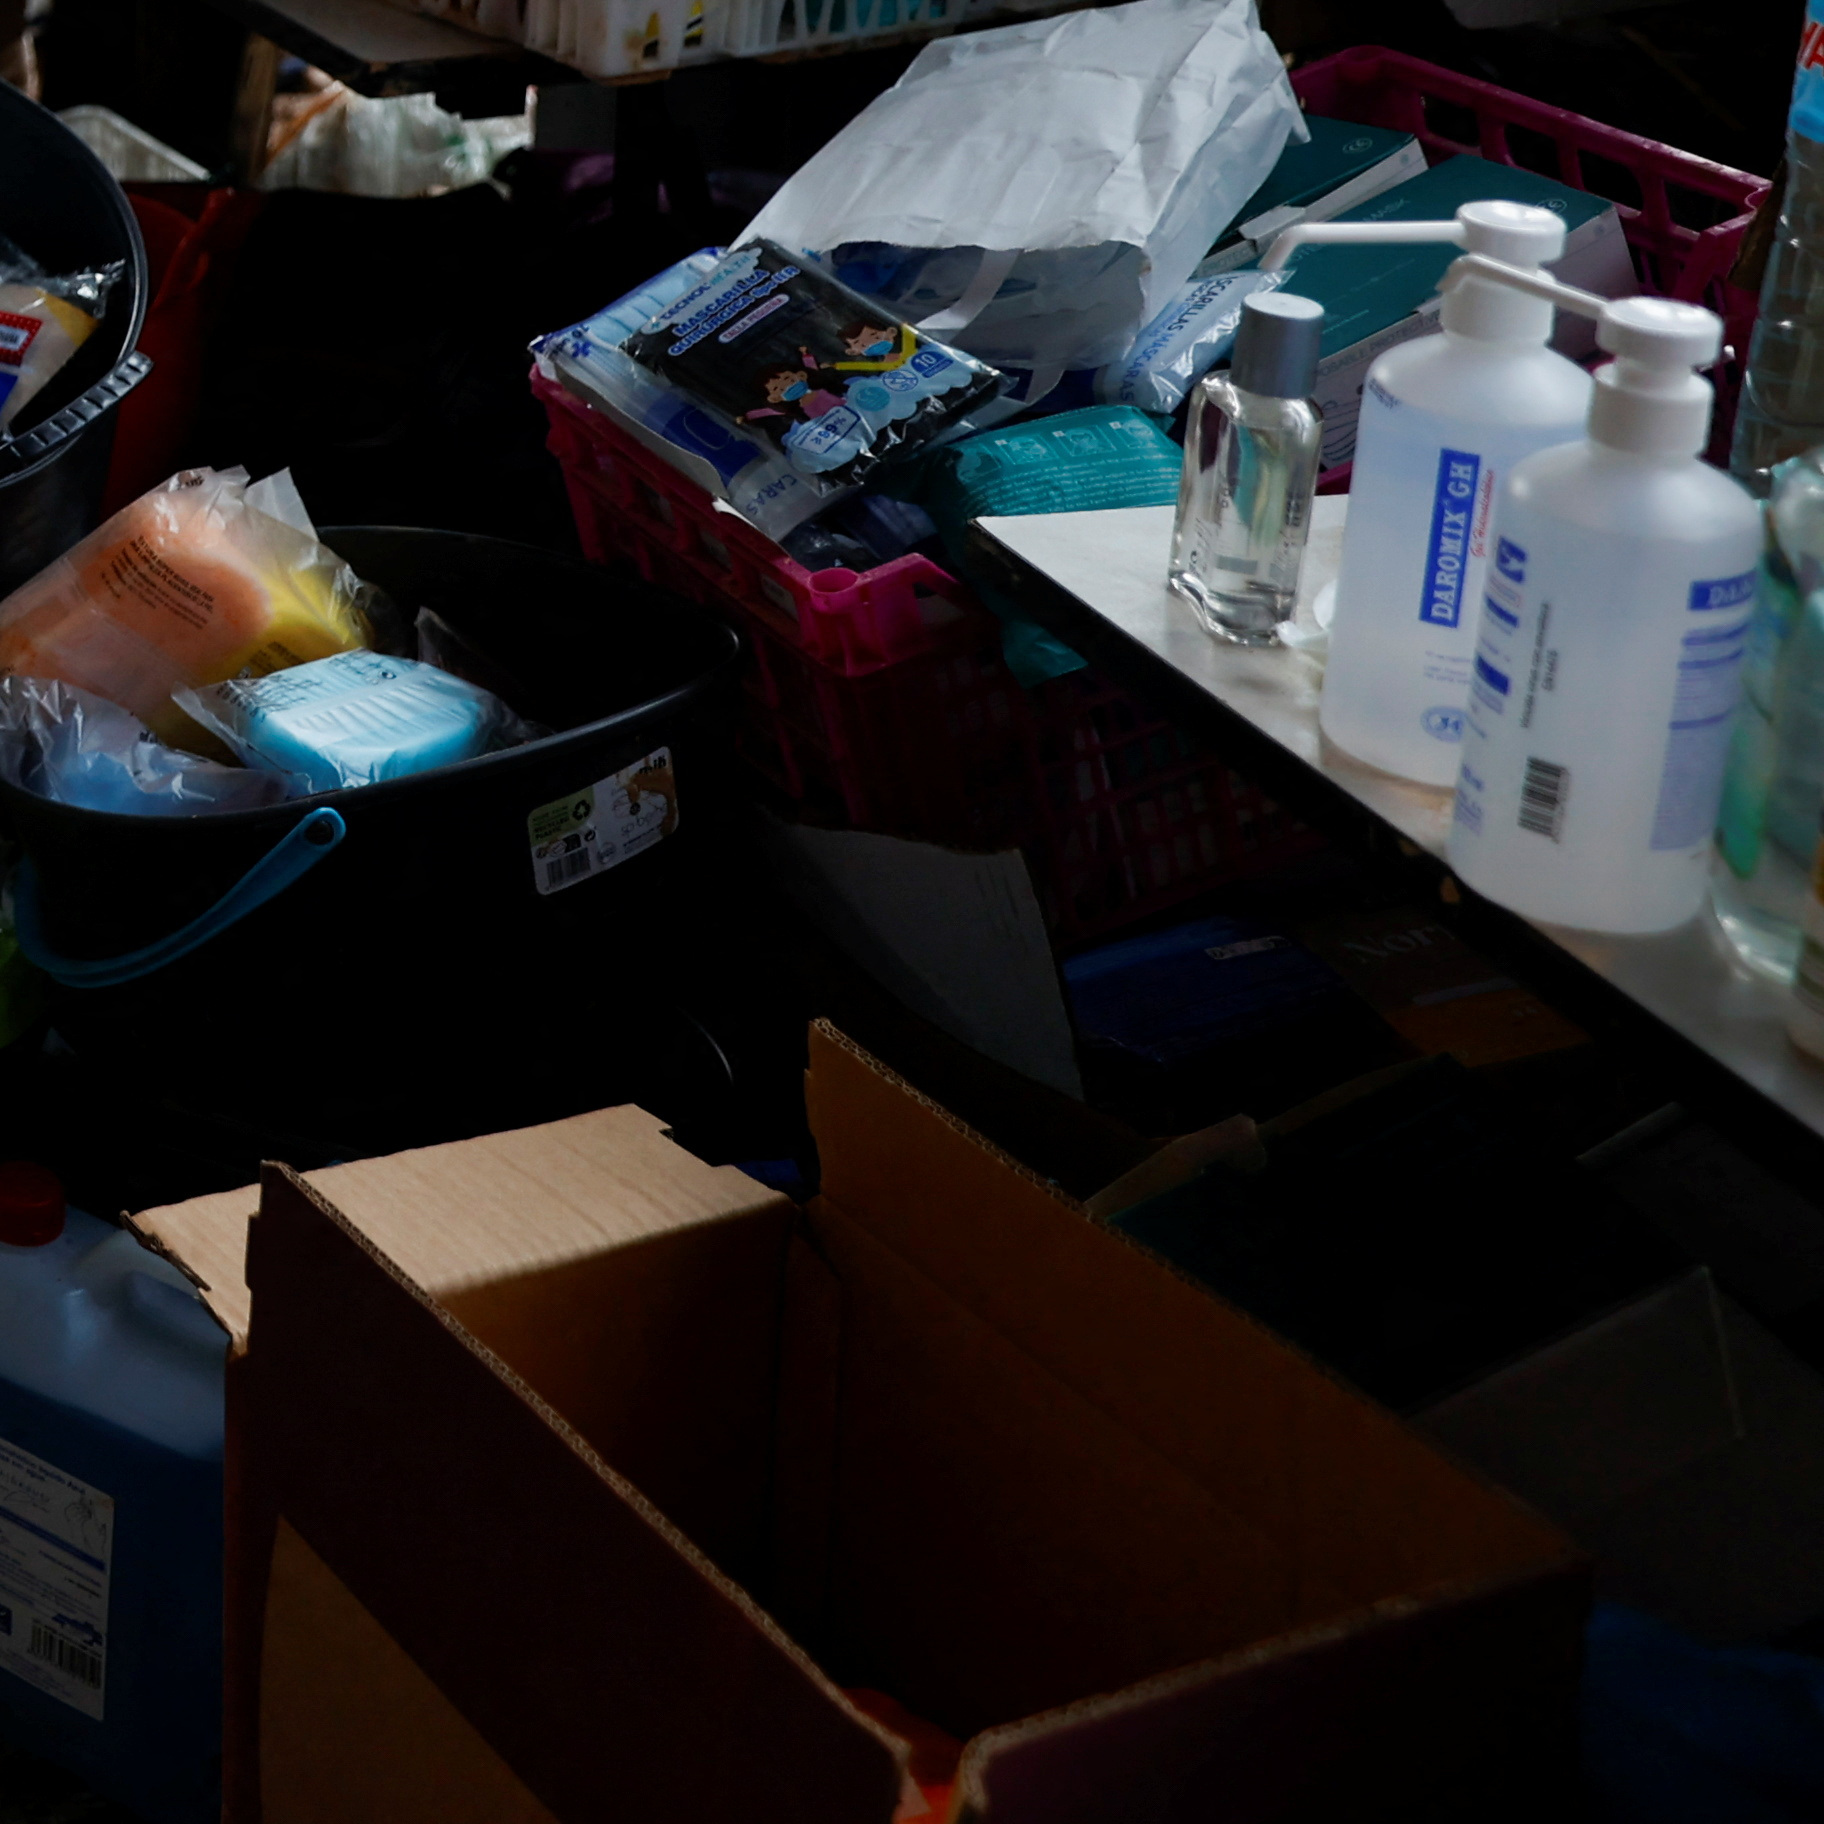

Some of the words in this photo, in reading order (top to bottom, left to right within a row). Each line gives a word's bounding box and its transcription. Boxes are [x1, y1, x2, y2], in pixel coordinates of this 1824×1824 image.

[673, 267, 770, 337] MASCARILLA
[1447, 460, 1474, 499] GH
[1430, 504, 1468, 623] DAROMIX
